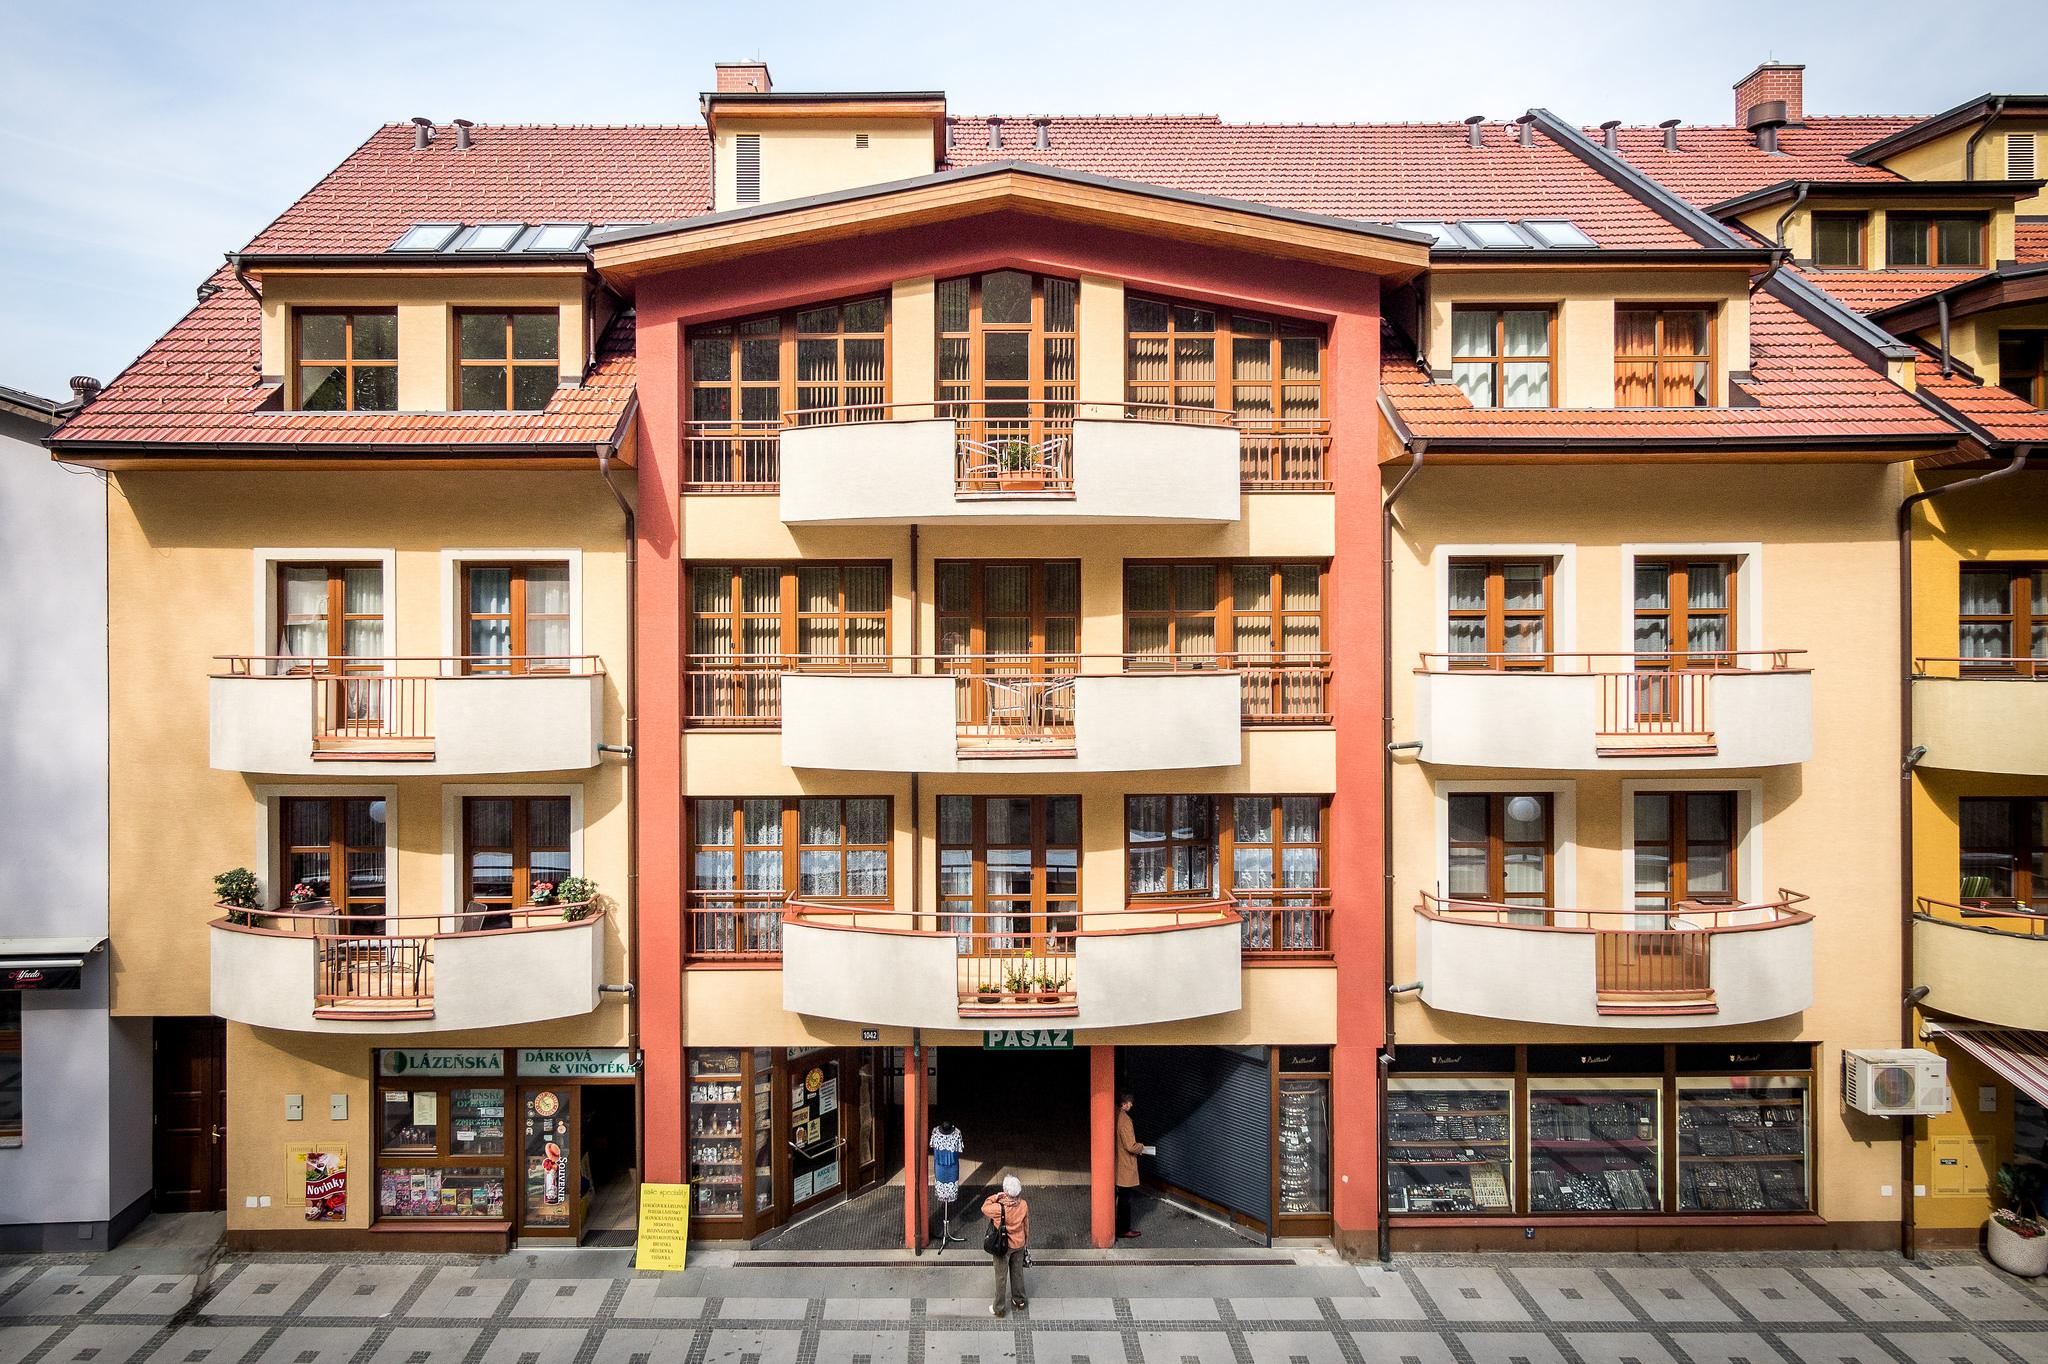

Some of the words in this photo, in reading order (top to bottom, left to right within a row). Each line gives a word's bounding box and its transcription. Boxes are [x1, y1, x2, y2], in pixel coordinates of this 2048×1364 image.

[863, 1031, 877, 1039] 1042
[409, 1052, 500, 1069] LÁZEŇSKÁ
[525, 1050, 592, 1062] DÁRKOVÁ
[549, 1063, 560, 1073] &
[565, 1061, 636, 1074] VINOTÉKA
[307, 1178, 345, 1195] Novinky
[558, 1157, 568, 1203] SOUVENIR
